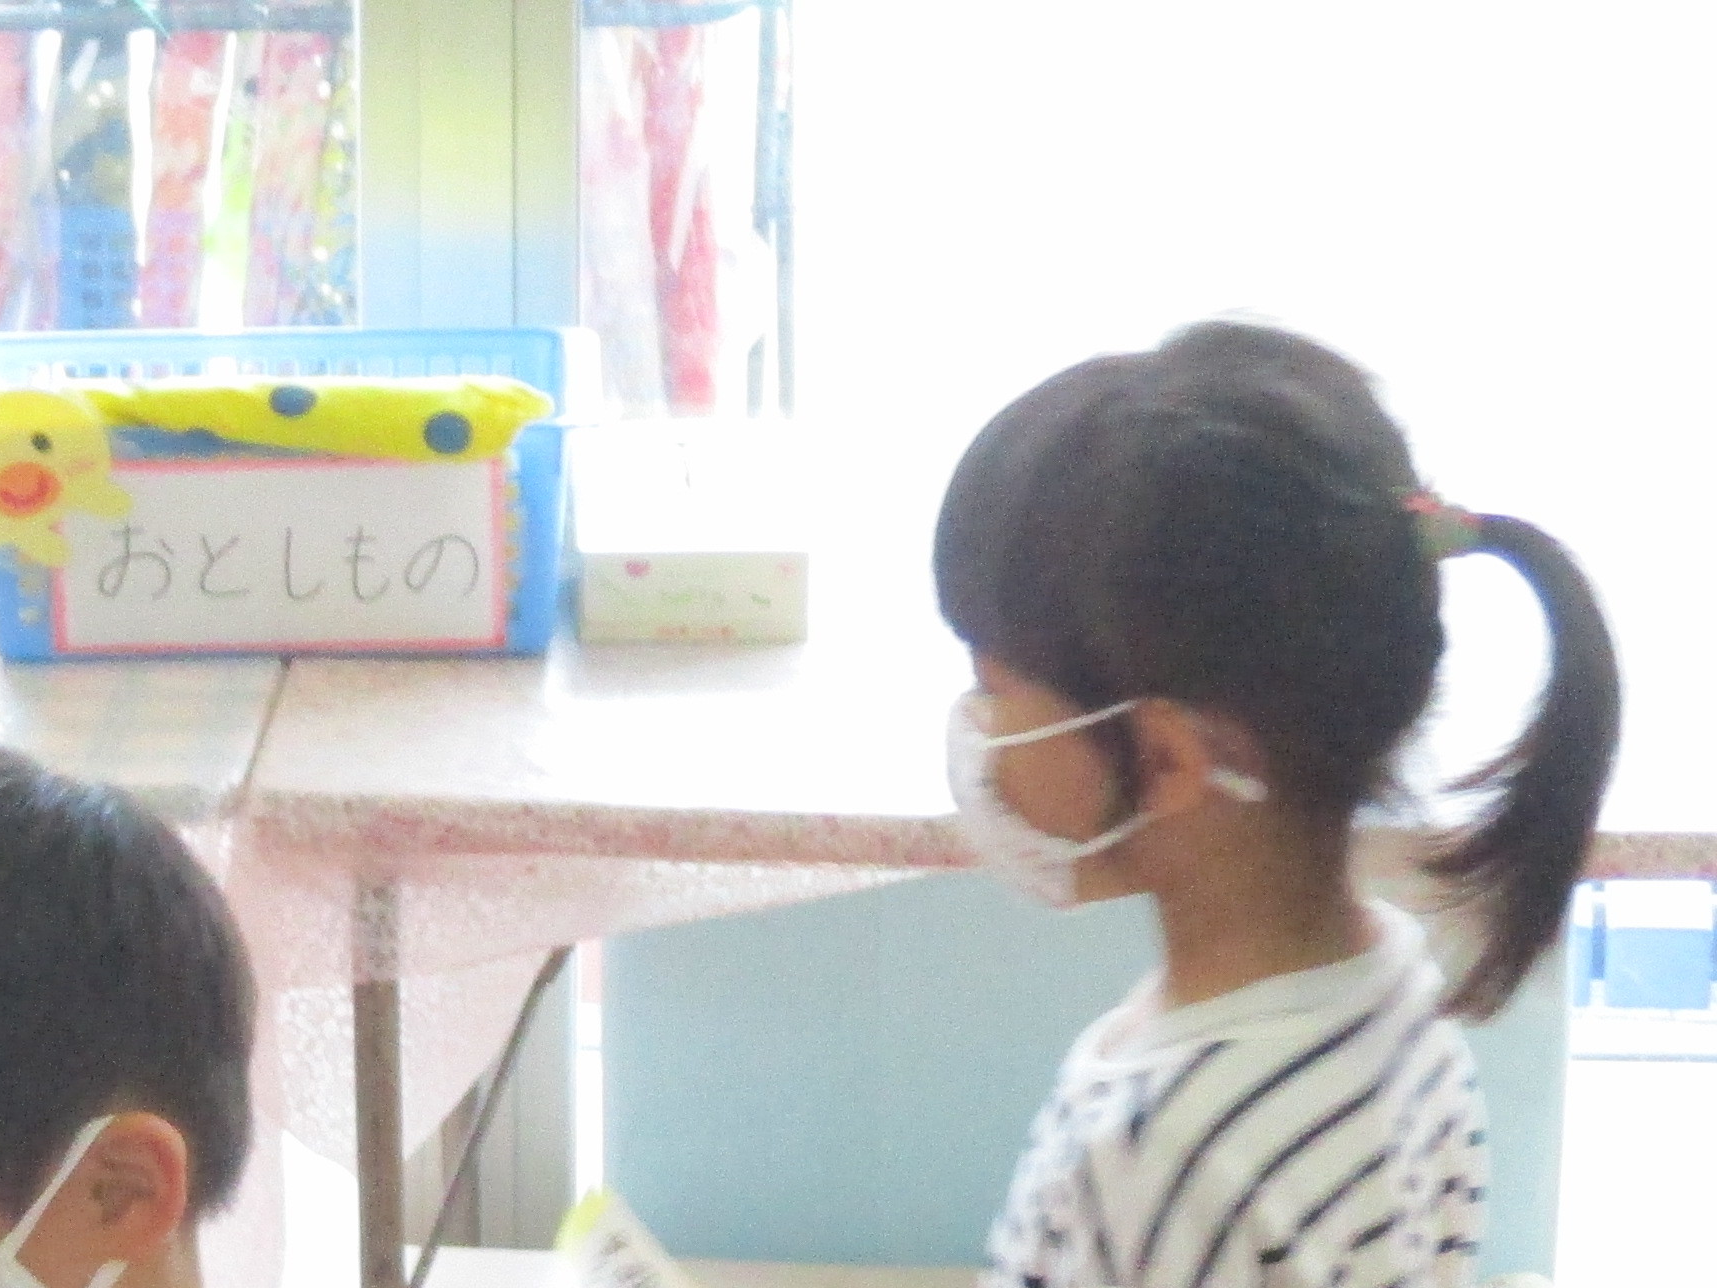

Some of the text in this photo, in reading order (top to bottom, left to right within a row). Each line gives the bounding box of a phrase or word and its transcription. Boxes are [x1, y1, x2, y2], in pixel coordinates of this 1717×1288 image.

[97, 525, 479, 601] おとしもの
